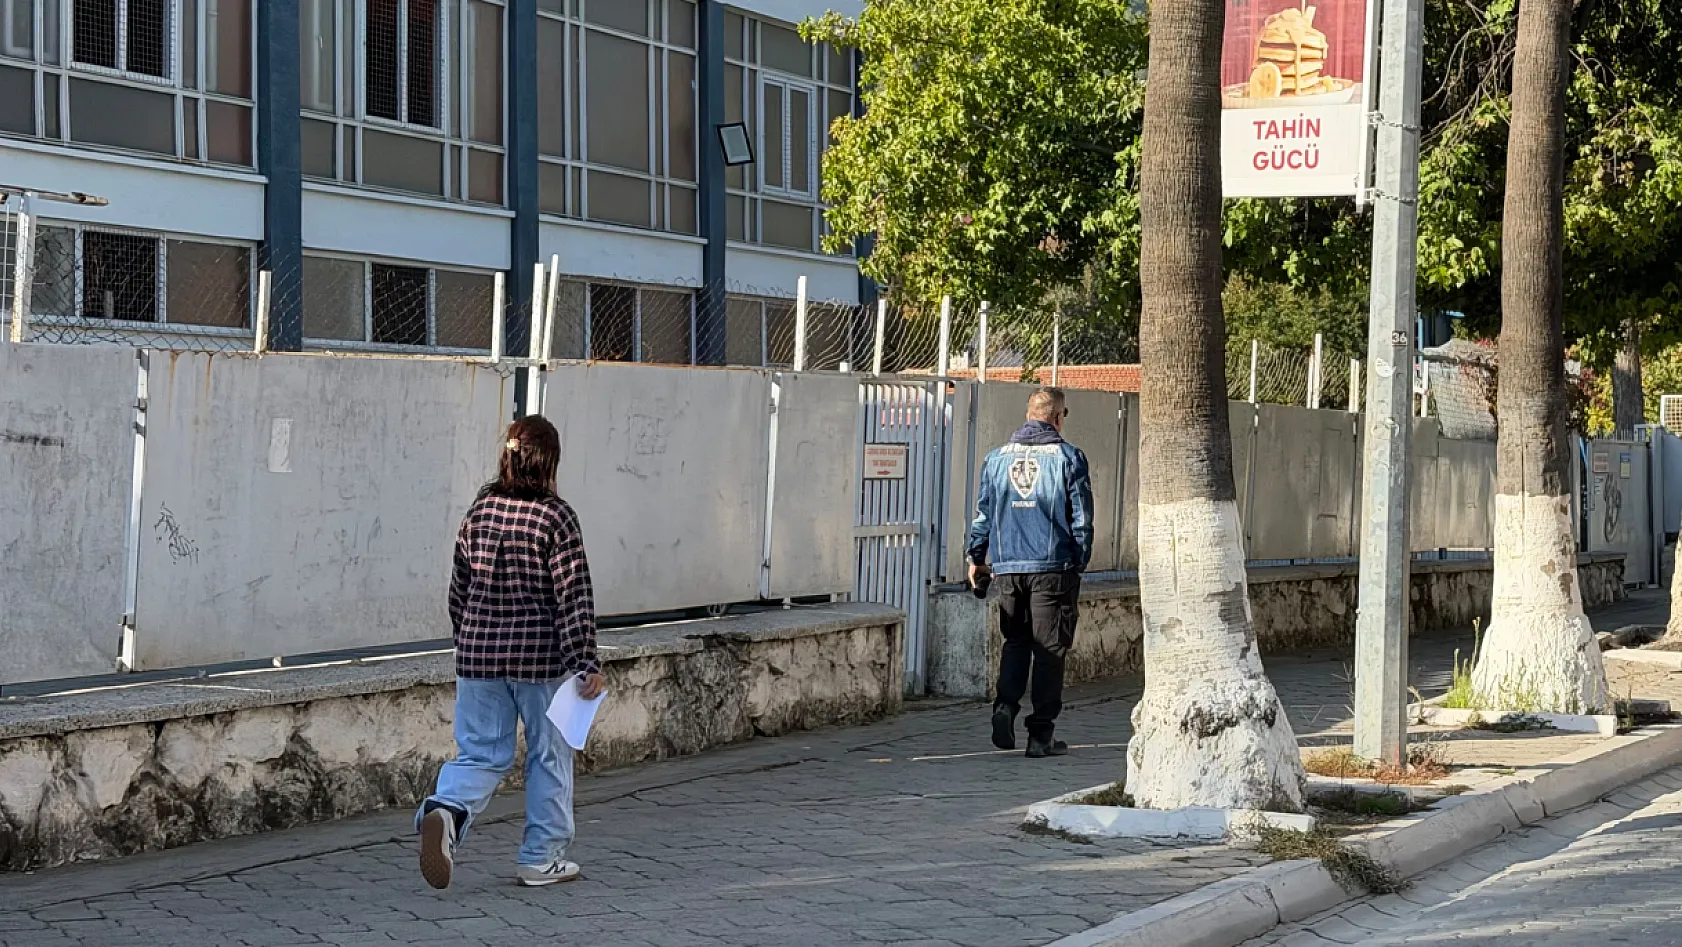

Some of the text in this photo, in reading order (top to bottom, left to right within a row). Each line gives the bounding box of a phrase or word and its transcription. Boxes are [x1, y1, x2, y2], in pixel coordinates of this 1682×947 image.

[1253, 113, 1321, 140] TAHİN
[1253, 144, 1320, 171] GÜCÜ
[1392, 332, 1407, 343] 36
